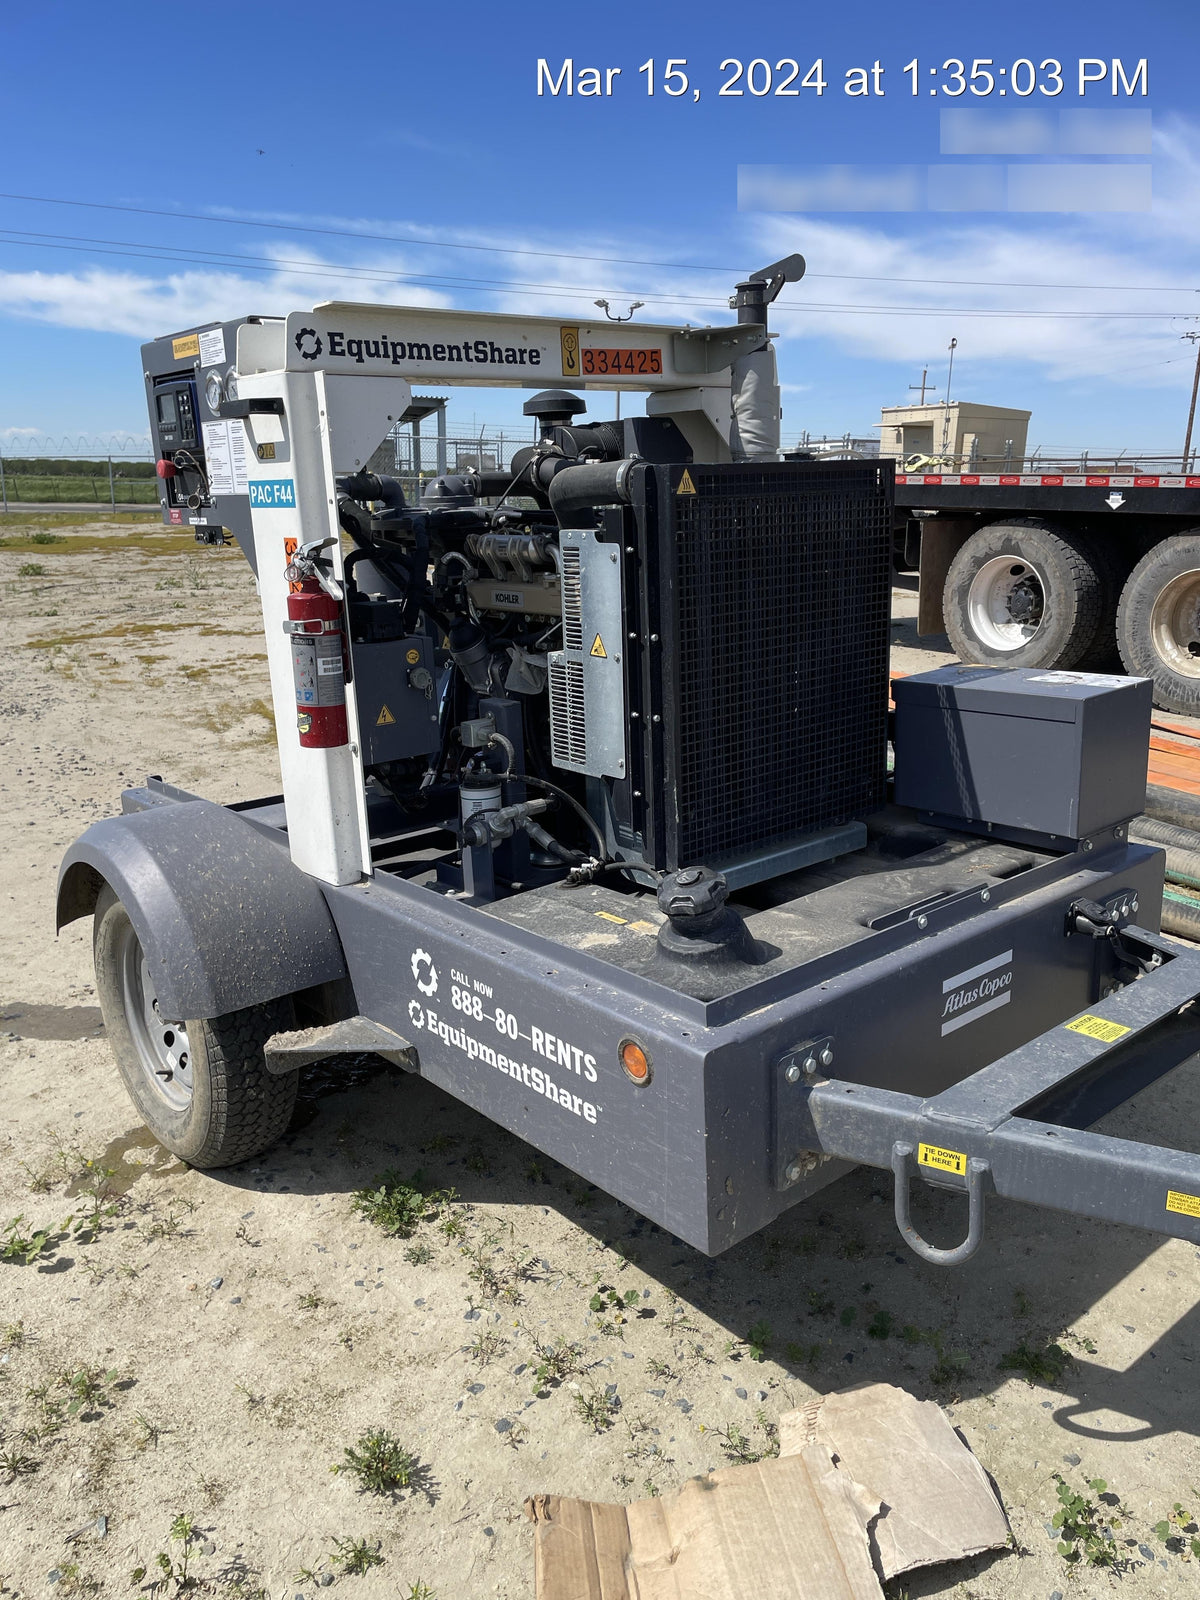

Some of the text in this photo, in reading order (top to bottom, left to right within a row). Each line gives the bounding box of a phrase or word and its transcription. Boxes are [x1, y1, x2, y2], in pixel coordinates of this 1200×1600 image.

[327, 331, 541, 366] EquipmentShare
[584, 350, 661, 374] 334425
[250, 484, 293, 503] PAC F44
[495, 592, 520, 604] KOHLER
[450, 968, 493, 998] CALL NOW
[451, 985, 598, 1083] 888-80-RENTS
[426, 1009, 598, 1125] EquipmentShare
[931, 1156, 952, 1166] HERE
[937, 1150, 961, 1161] DOWN
